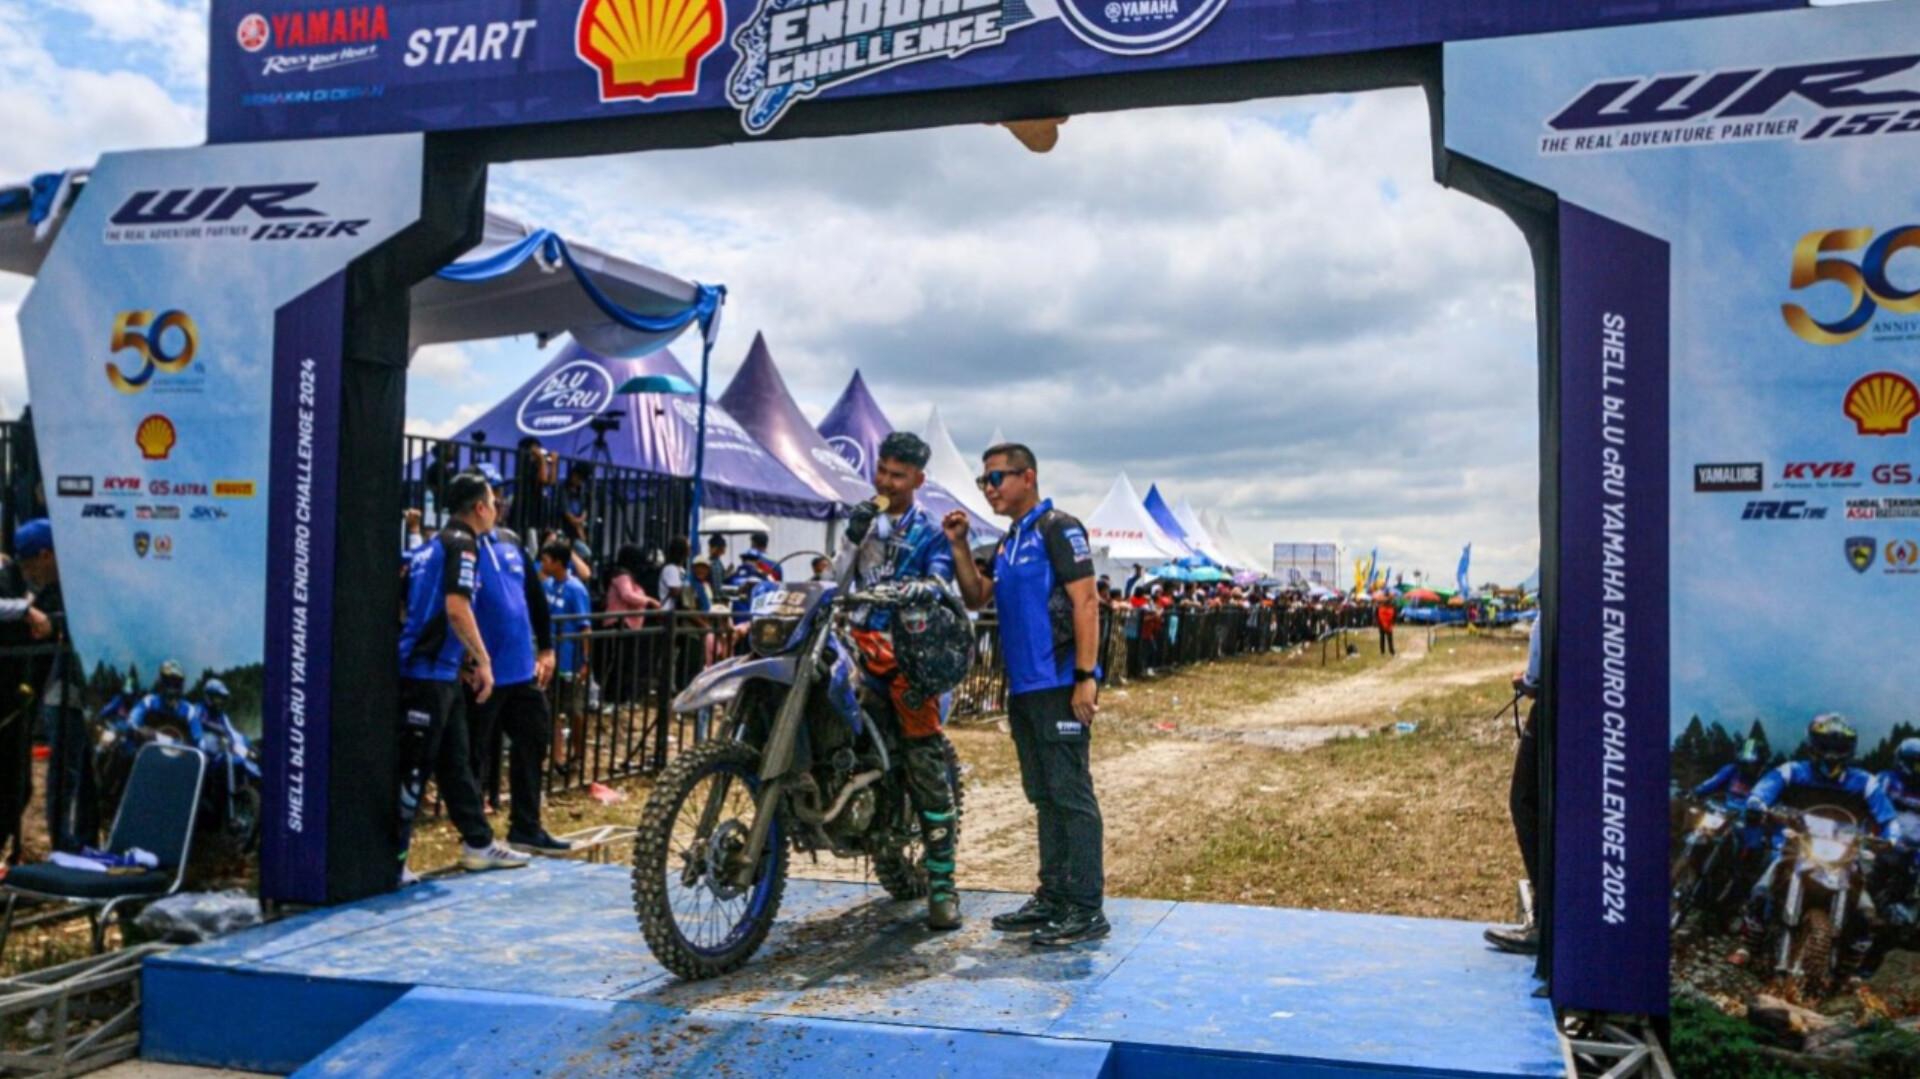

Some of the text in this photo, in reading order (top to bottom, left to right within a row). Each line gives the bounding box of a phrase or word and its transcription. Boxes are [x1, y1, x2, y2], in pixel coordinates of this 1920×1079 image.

[271, 5, 389, 48] YAMAHA
[1122, 0, 1178, 17] YAMAHA
[404, 20, 537, 67] START
[768, 10, 1002, 87] CHALLENGE
[1548, 54, 1920, 130] WR
[1541, 119, 1799, 152] THE REAL ADVENTURE PARTNER
[109, 181, 330, 226] WR
[249, 219, 371, 241] 155R
[105, 308, 199, 395] 50
[300, 358, 316, 406] 2024
[295, 408, 315, 522] CHALLENGE
[1699, 466, 1759, 484] YAMALUBE
[1783, 461, 1854, 479] KYB
[1872, 463, 1912, 484] GS
[173, 483, 208, 496] ASTRA
[293, 526, 311, 602] ENDURO
[1603, 312, 1625, 924] SHELL bLU cRU YAMAHA ENDURO CHALLENGE 2024
[291, 607, 308, 683] YAMAHA
[290, 729, 305, 768] bLU
[288, 771, 304, 832] SHELL
